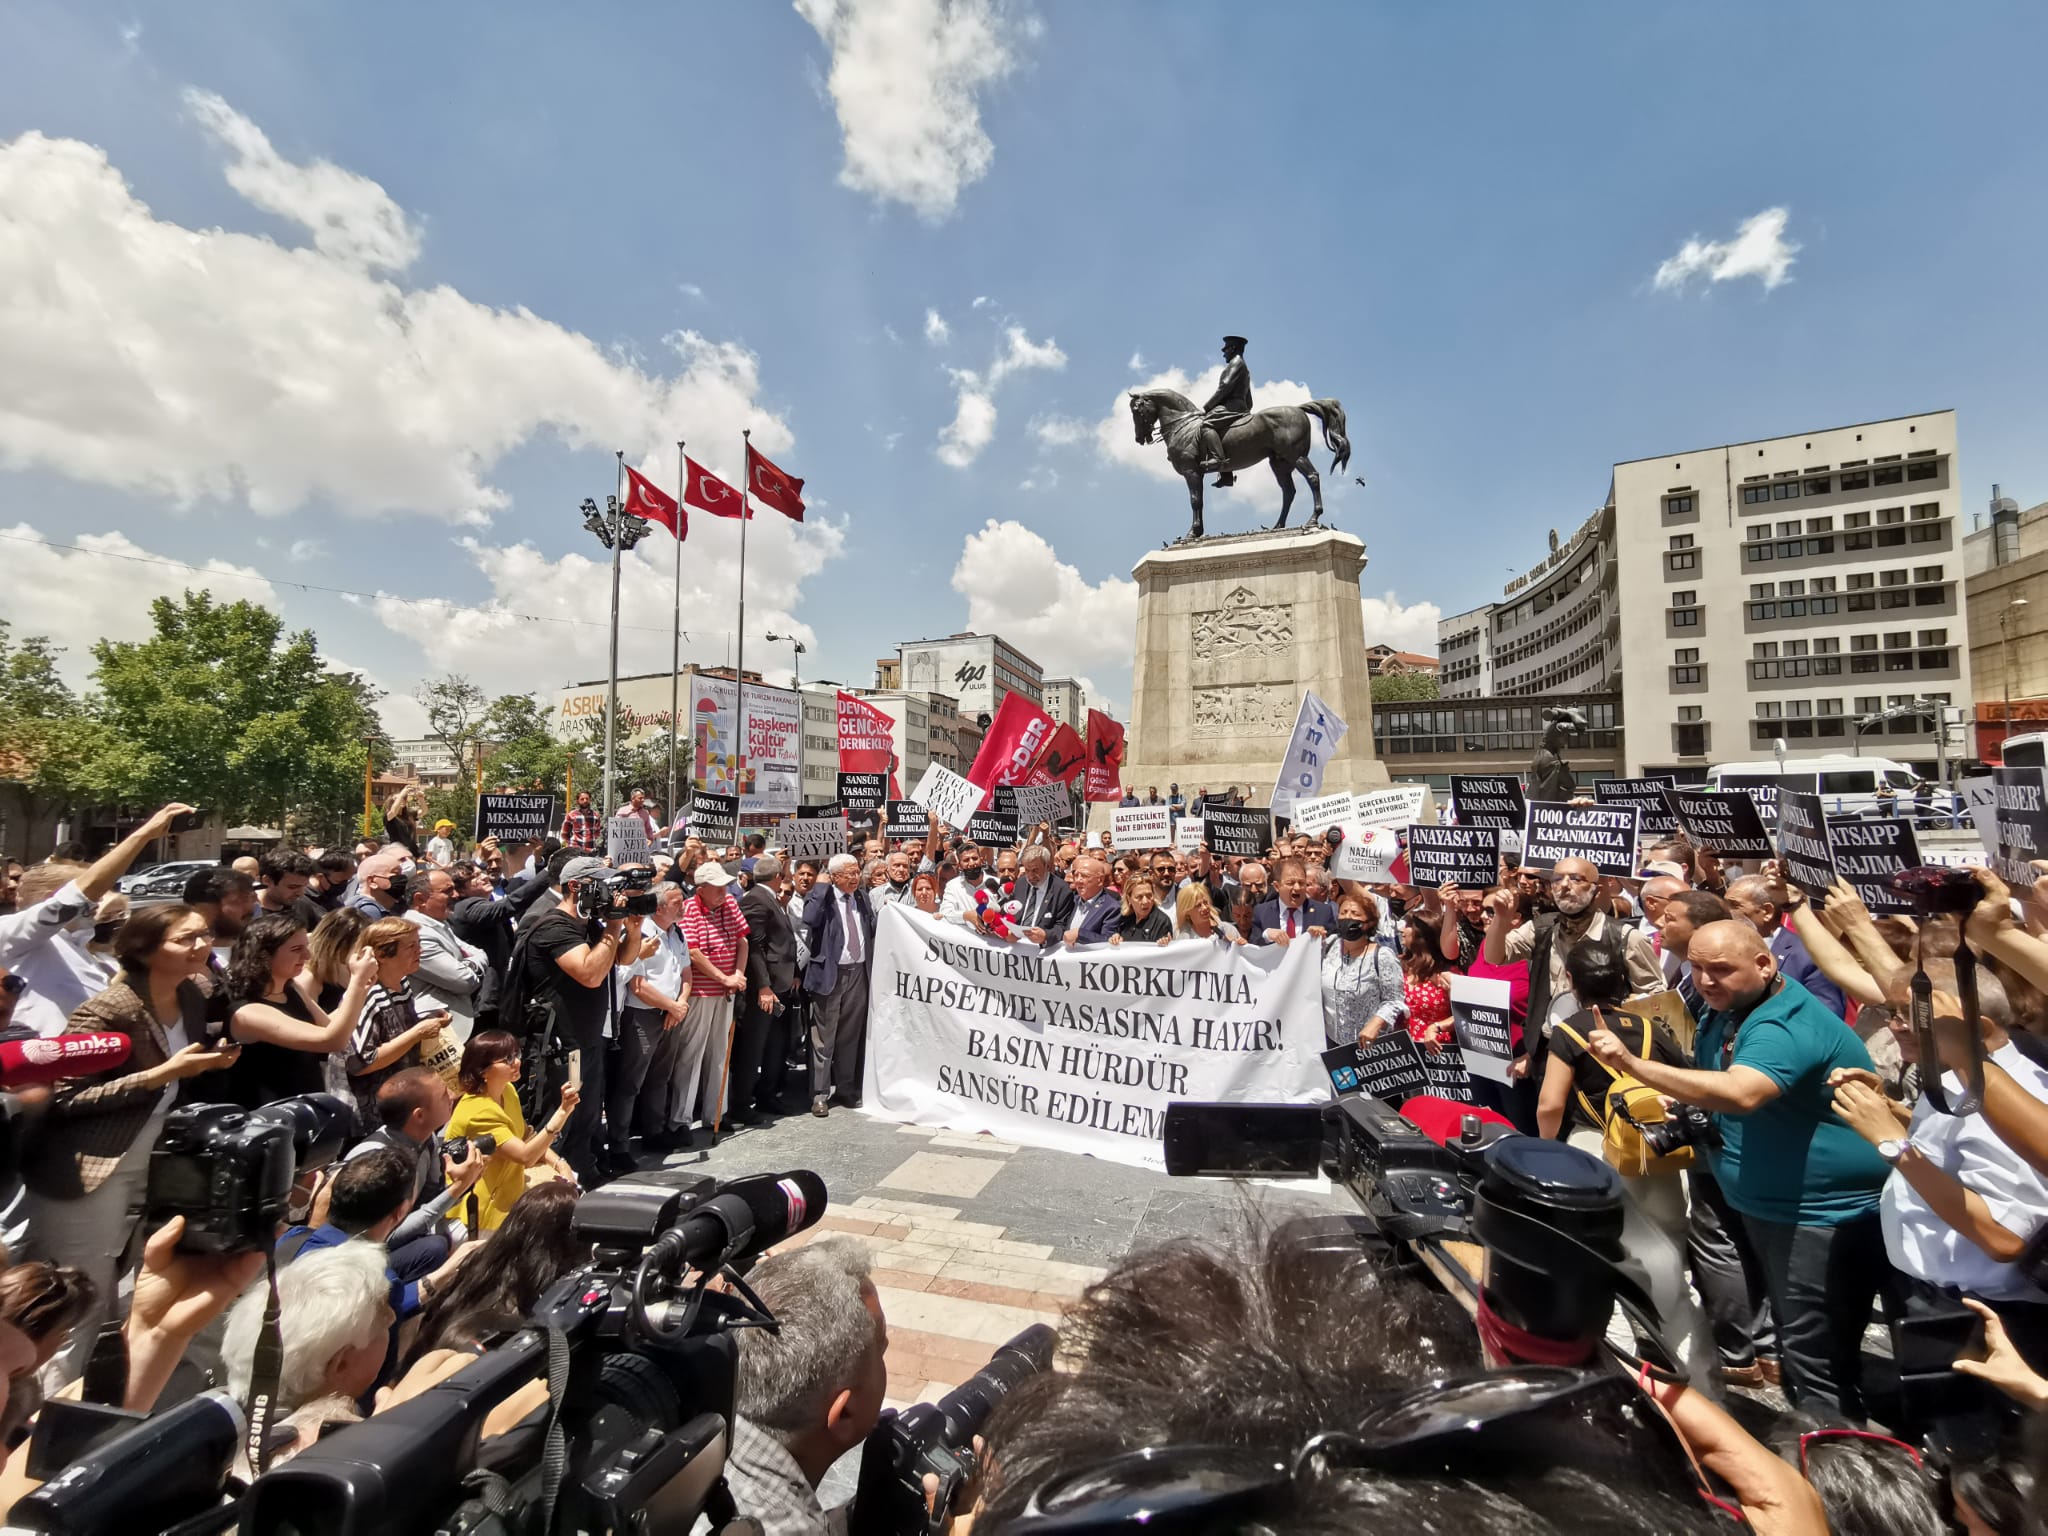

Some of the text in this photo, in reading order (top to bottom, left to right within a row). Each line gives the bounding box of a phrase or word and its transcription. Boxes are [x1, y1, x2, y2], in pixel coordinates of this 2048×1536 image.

[561, 694, 604, 717] ASBÜ
[624, 704, 682, 728] Üniversitei
[749, 714, 798, 733] başkent
[749, 730, 786, 750] kültür
[749, 744, 776, 760] yolu
[845, 774, 879, 785] SANSÜR
[1461, 779, 1508, 794] SANSÜR
[1600, 781, 1664, 794] YEREL BASIN
[842, 787, 882, 797] YASASINA
[487, 796, 548, 808] WHATSAPP
[694, 797, 729, 812] SOSYAL
[848, 798, 875, 808] HAYIR
[1459, 798, 1518, 811] YASASINA
[1679, 798, 1733, 816] ÖZGÜR
[486, 812, 545, 824] MESAJIMA
[899, 815, 925, 823] BASIN
[971, 819, 1002, 830] BUGÜN
[1116, 812, 1165, 822] GAZETECİLİKTE
[1205, 810, 1269, 824] BASINSIZ BASIN
[1472, 815, 1512, 828] HAYIR
[1533, 809, 1632, 829] 1000 GAZETE
[788, 821, 839, 833] SANSÜR
[1133, 821, 1166, 831] EDİYORUZ!
[1214, 825, 1258, 838] YASASINA
[1687, 817, 1735, 834] BASIN
[783, 832, 845, 843] YASASINA
[972, 830, 999, 841] YARIN
[1537, 828, 1625, 847] KAPANMAYLA
[1829, 824, 1900, 846] ATSAPP
[784, 841, 844, 857] HAYIR
[1214, 839, 1260, 854] HAYIR!
[1414, 850, 1493, 866] AYKIRI YASA
[1528, 845, 1631, 866] KARŞI KARŞIYA!
[1836, 855, 1906, 875] SAJIMA
[1414, 866, 1436, 882] GERİ
[924, 936, 1258, 1010] SUSTURMA, KORKUTMA,
[895, 970, 1284, 1052] HAPSETME YASASINA HAYIR!
[1471, 1009, 1502, 1024] SOSYAL
[1917, 1000, 1929, 1028] Nikon
[1468, 1021, 1508, 1040] MEDYAMA
[64, 1035, 121, 1051] anka
[1355, 1040, 1402, 1062] SOSYAL
[1471, 1039, 1510, 1055] DOKUNMA
[967, 1028, 1189, 1096] BASIN HÜRDÜR
[1354, 1053, 1417, 1080] MEDYAMA
[1361, 1068, 1425, 1095] DOKUNMA
[937, 1064, 1165, 1141] SANSÜR EDİLEM
